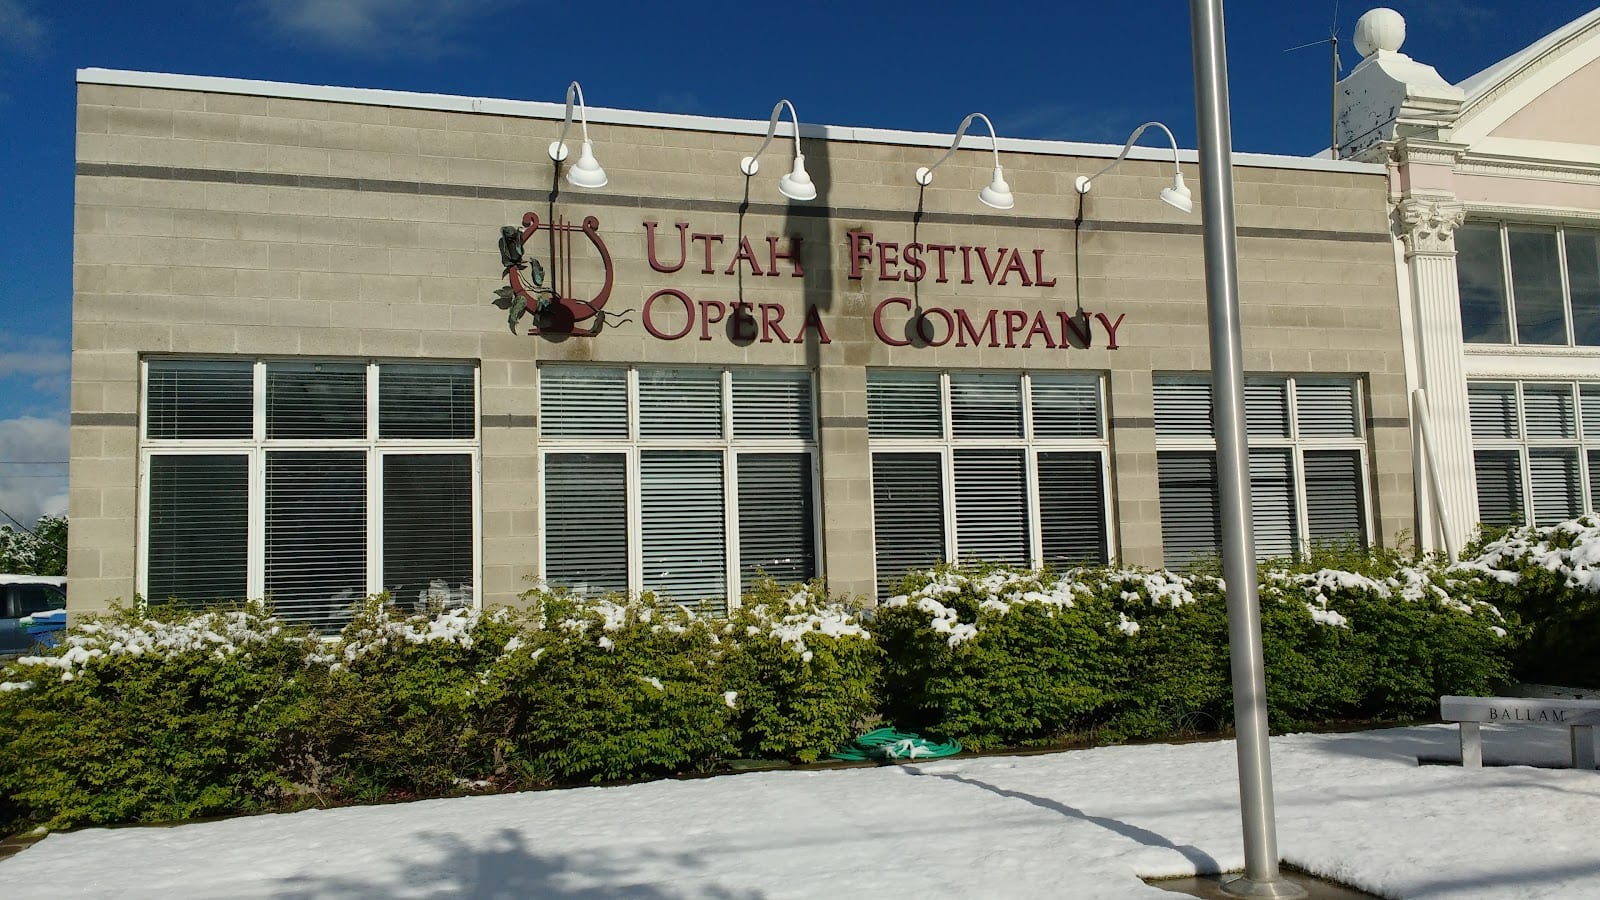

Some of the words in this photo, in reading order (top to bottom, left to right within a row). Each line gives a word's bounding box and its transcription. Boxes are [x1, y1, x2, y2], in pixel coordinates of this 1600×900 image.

[643, 221, 805, 278] UTAH
[847, 232, 1057, 287] FESTIVAL
[642, 288, 832, 344] OPERA
[873, 297, 1126, 350] COMPANY
